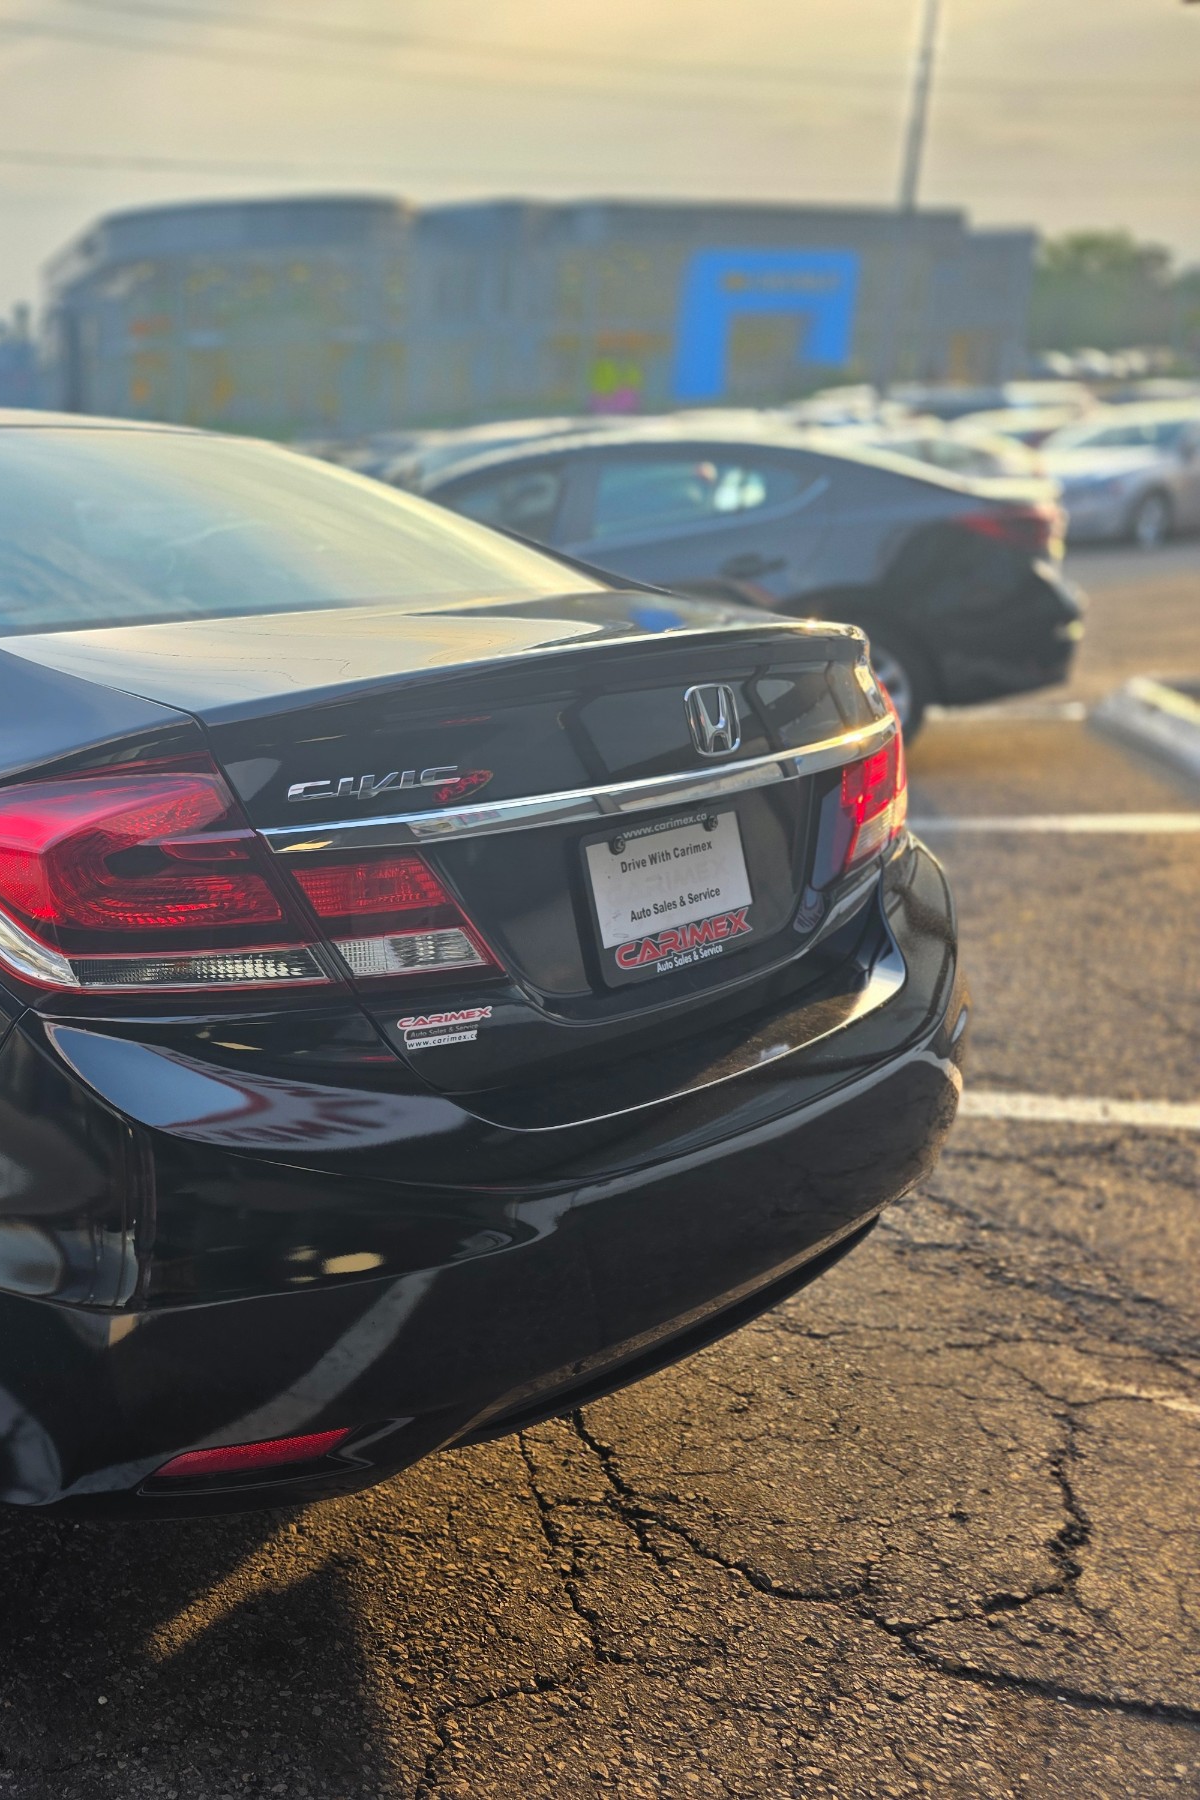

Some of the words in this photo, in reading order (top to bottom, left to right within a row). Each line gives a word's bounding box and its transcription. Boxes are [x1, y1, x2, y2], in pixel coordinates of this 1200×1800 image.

[288, 766, 460, 801] CIVIC
[623, 814, 708, 839] www.carimex.ca
[620, 859, 647, 873] Drive
[648, 852, 672, 866] With
[673, 841, 713, 859] Carimex
[630, 906, 652, 922] Auto
[653, 899, 678, 915] Sales
[679, 896, 687, 906] &
[688, 887, 721, 905] Service
[615, 907, 753, 970] CARIMEX
[656, 959, 673, 973] Auto
[674, 954, 692, 968] Sales
[693, 951, 699, 961] &
[700, 944, 723, 960] Service
[399, 1007, 491, 1029] CARIMEX
[428, 1028, 447, 1036] Sales
[455, 1023, 479, 1032] Service
